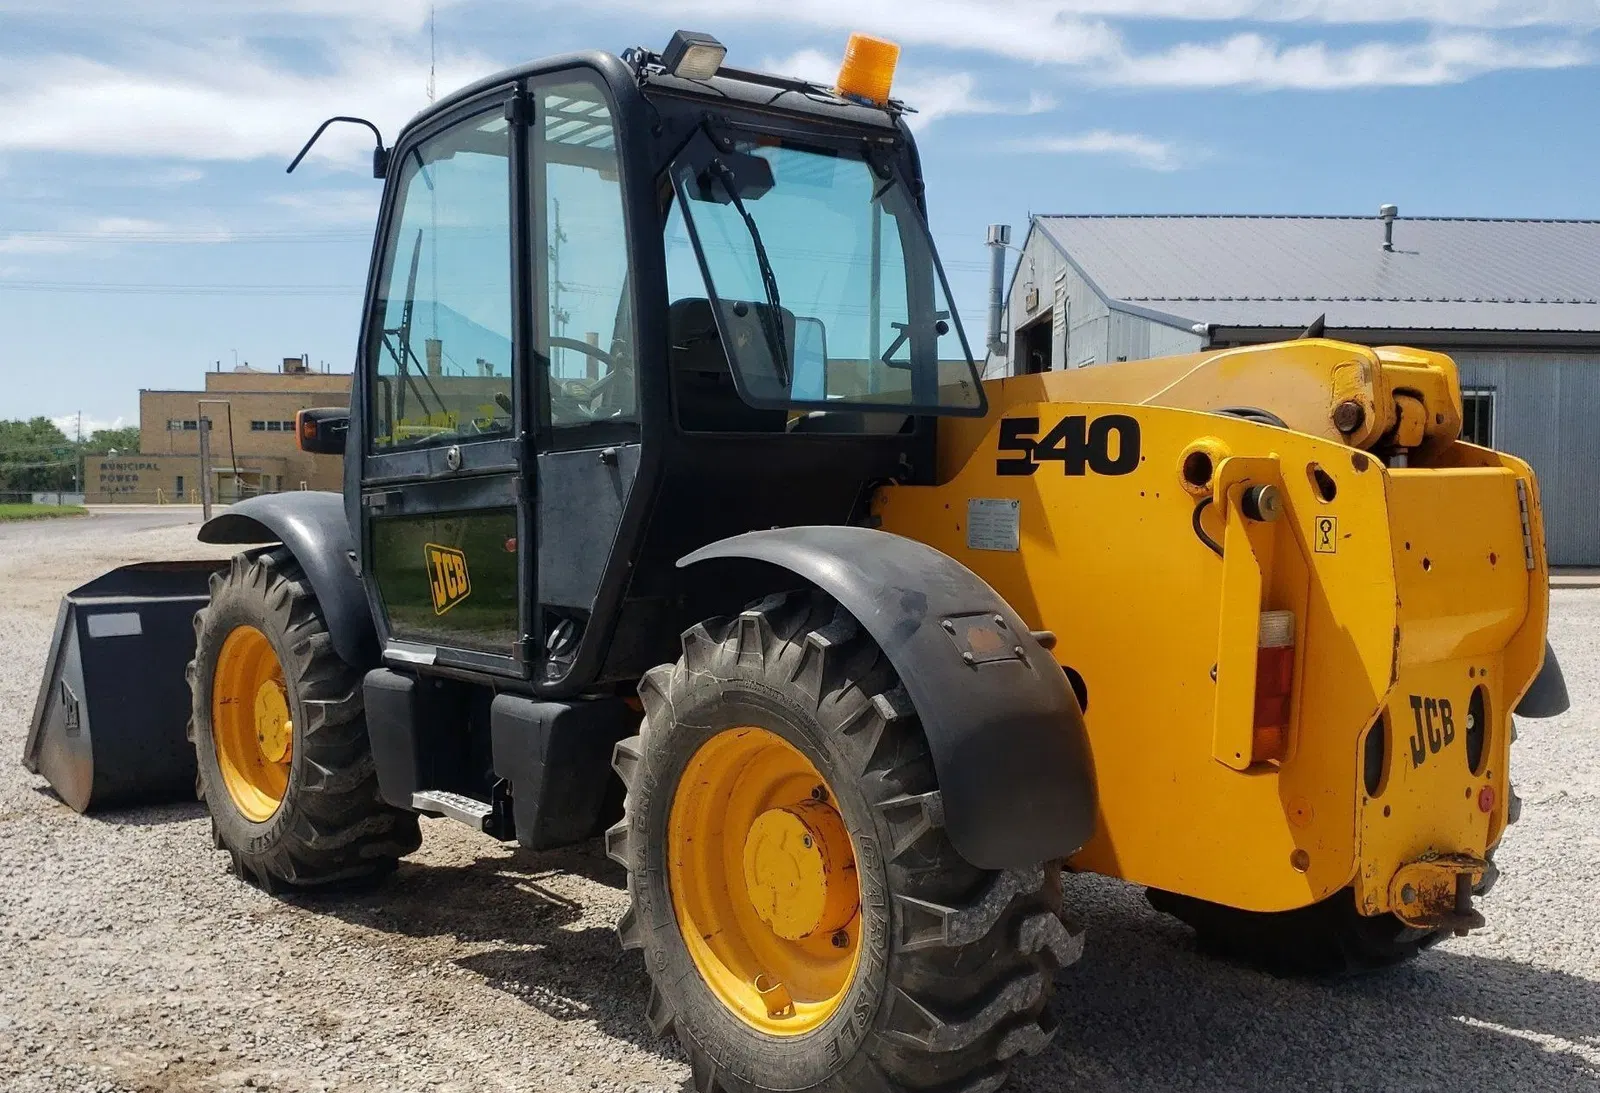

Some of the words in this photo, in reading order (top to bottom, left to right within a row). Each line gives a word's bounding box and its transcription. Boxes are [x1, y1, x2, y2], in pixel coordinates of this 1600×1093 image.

[100, 462, 160, 471] MUNICIPAL
[996, 413, 1141, 477] 540
[100, 474, 139, 482] POWER
[431, 550, 467, 609] JCB
[1409, 694, 1455, 769] JCB
[823, 834, 889, 1070] CARLISLE
